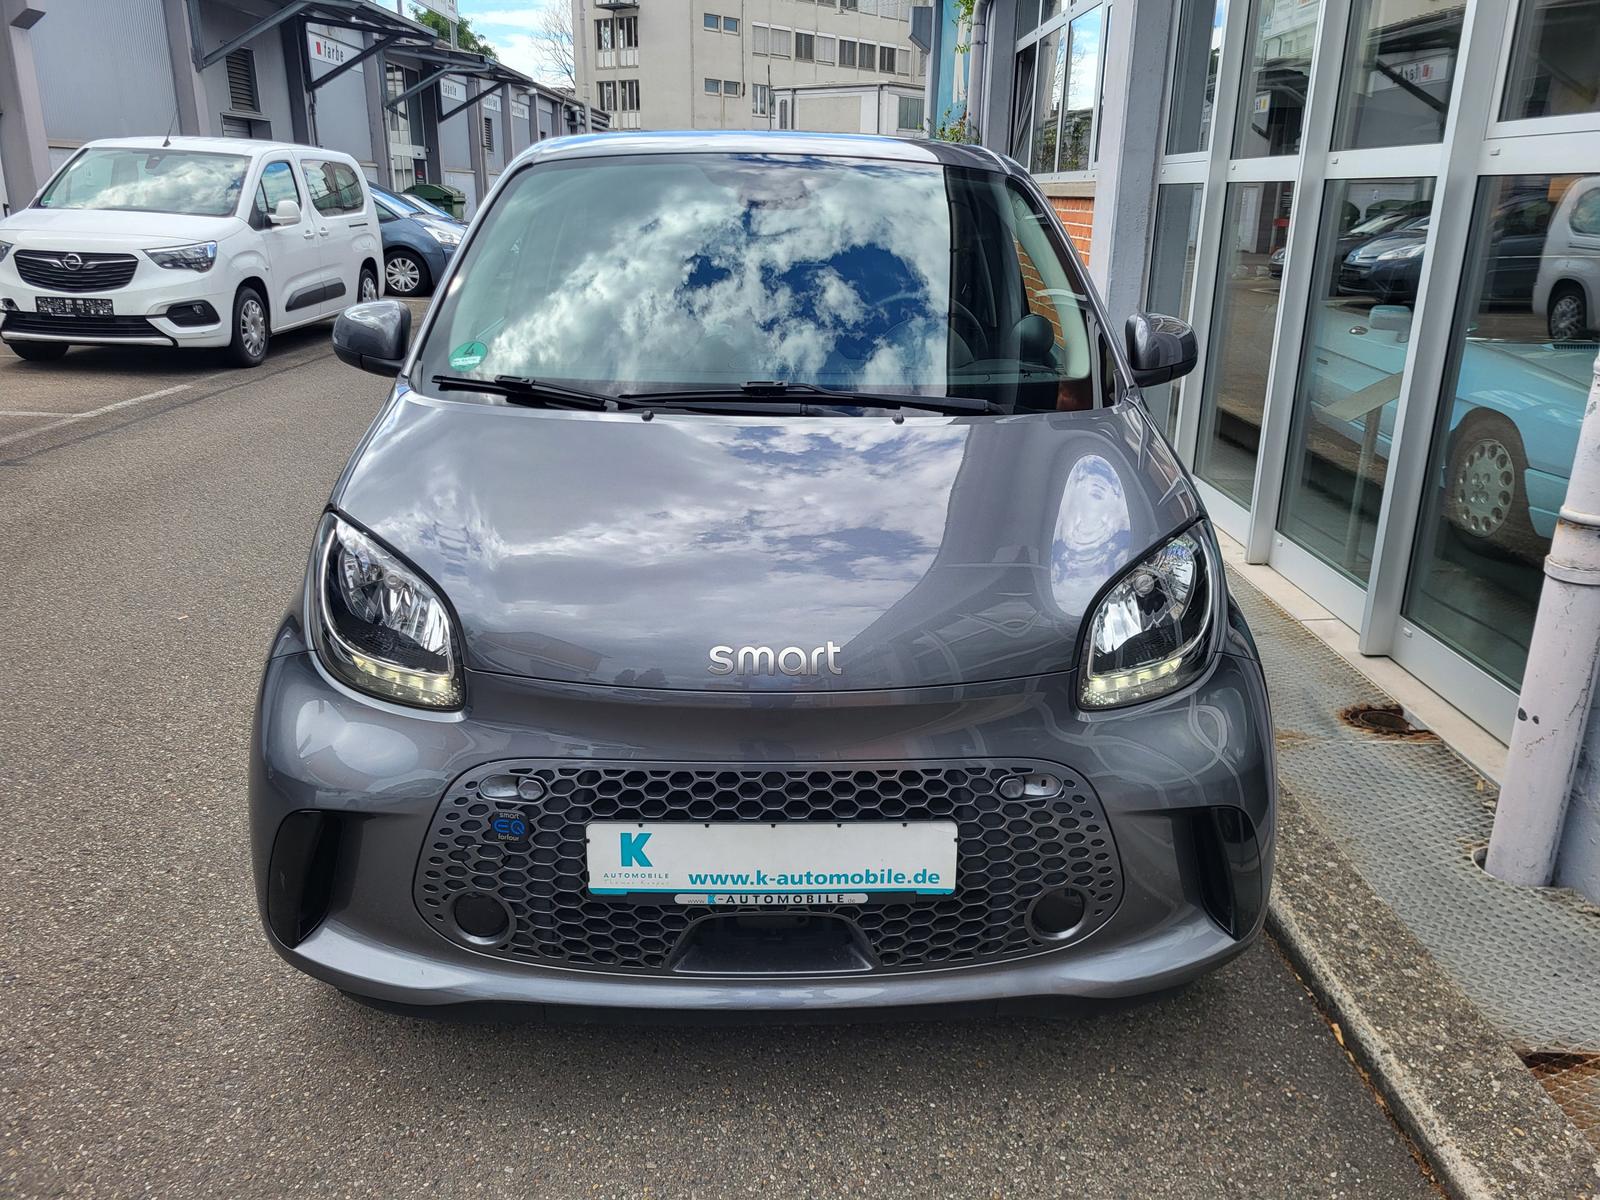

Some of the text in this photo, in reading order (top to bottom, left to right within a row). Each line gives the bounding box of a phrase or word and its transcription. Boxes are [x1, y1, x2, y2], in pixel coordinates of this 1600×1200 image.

[324, 40, 344, 62] farbe
[463, 342, 475, 356] 4
[707, 640, 842, 676] smart
[494, 819, 525, 835] EQ
[497, 833, 519, 841] forfour
[620, 832, 653, 867] K
[688, 869, 940, 886] www.k-automobile.de
